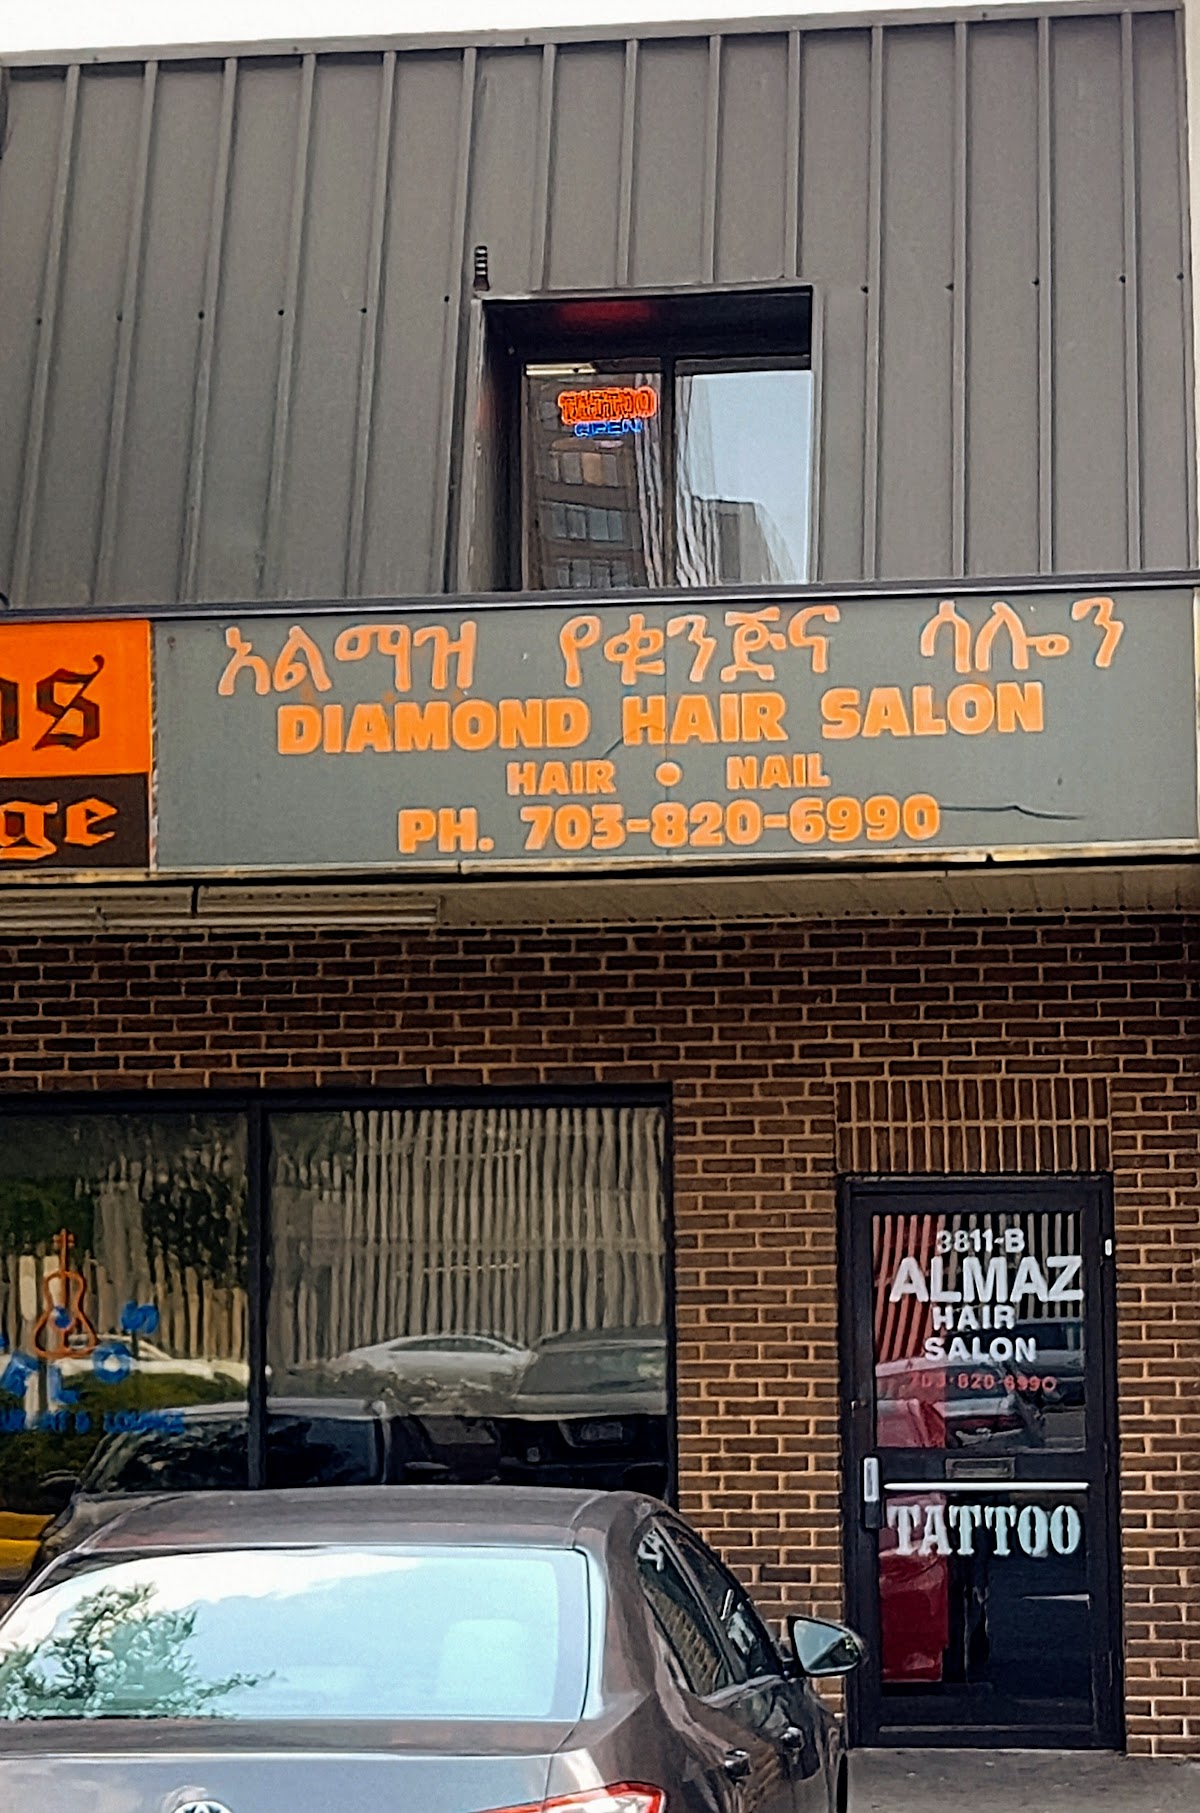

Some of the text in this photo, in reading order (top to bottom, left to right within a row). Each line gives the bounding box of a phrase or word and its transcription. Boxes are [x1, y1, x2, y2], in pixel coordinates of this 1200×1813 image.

[558, 386, 657, 425] TATTOO
[574, 418, 643, 437] OPEN
[218, 620, 478, 696] አልማዝ
[920, 596, 1125, 673] ሳሎን
[277, 682, 1044, 755] DIAMOND HAIR SALON
[507, 753, 831, 797] HAIR NAIL
[398, 794, 942, 855] PH. 703-820-6990
[889, 1255, 1085, 1303] ALMAZ
[932, 1305, 1016, 1331] HAIR
[924, 1336, 1036, 1363] SALON
[886, 1504, 1081, 1557] TATTOO
